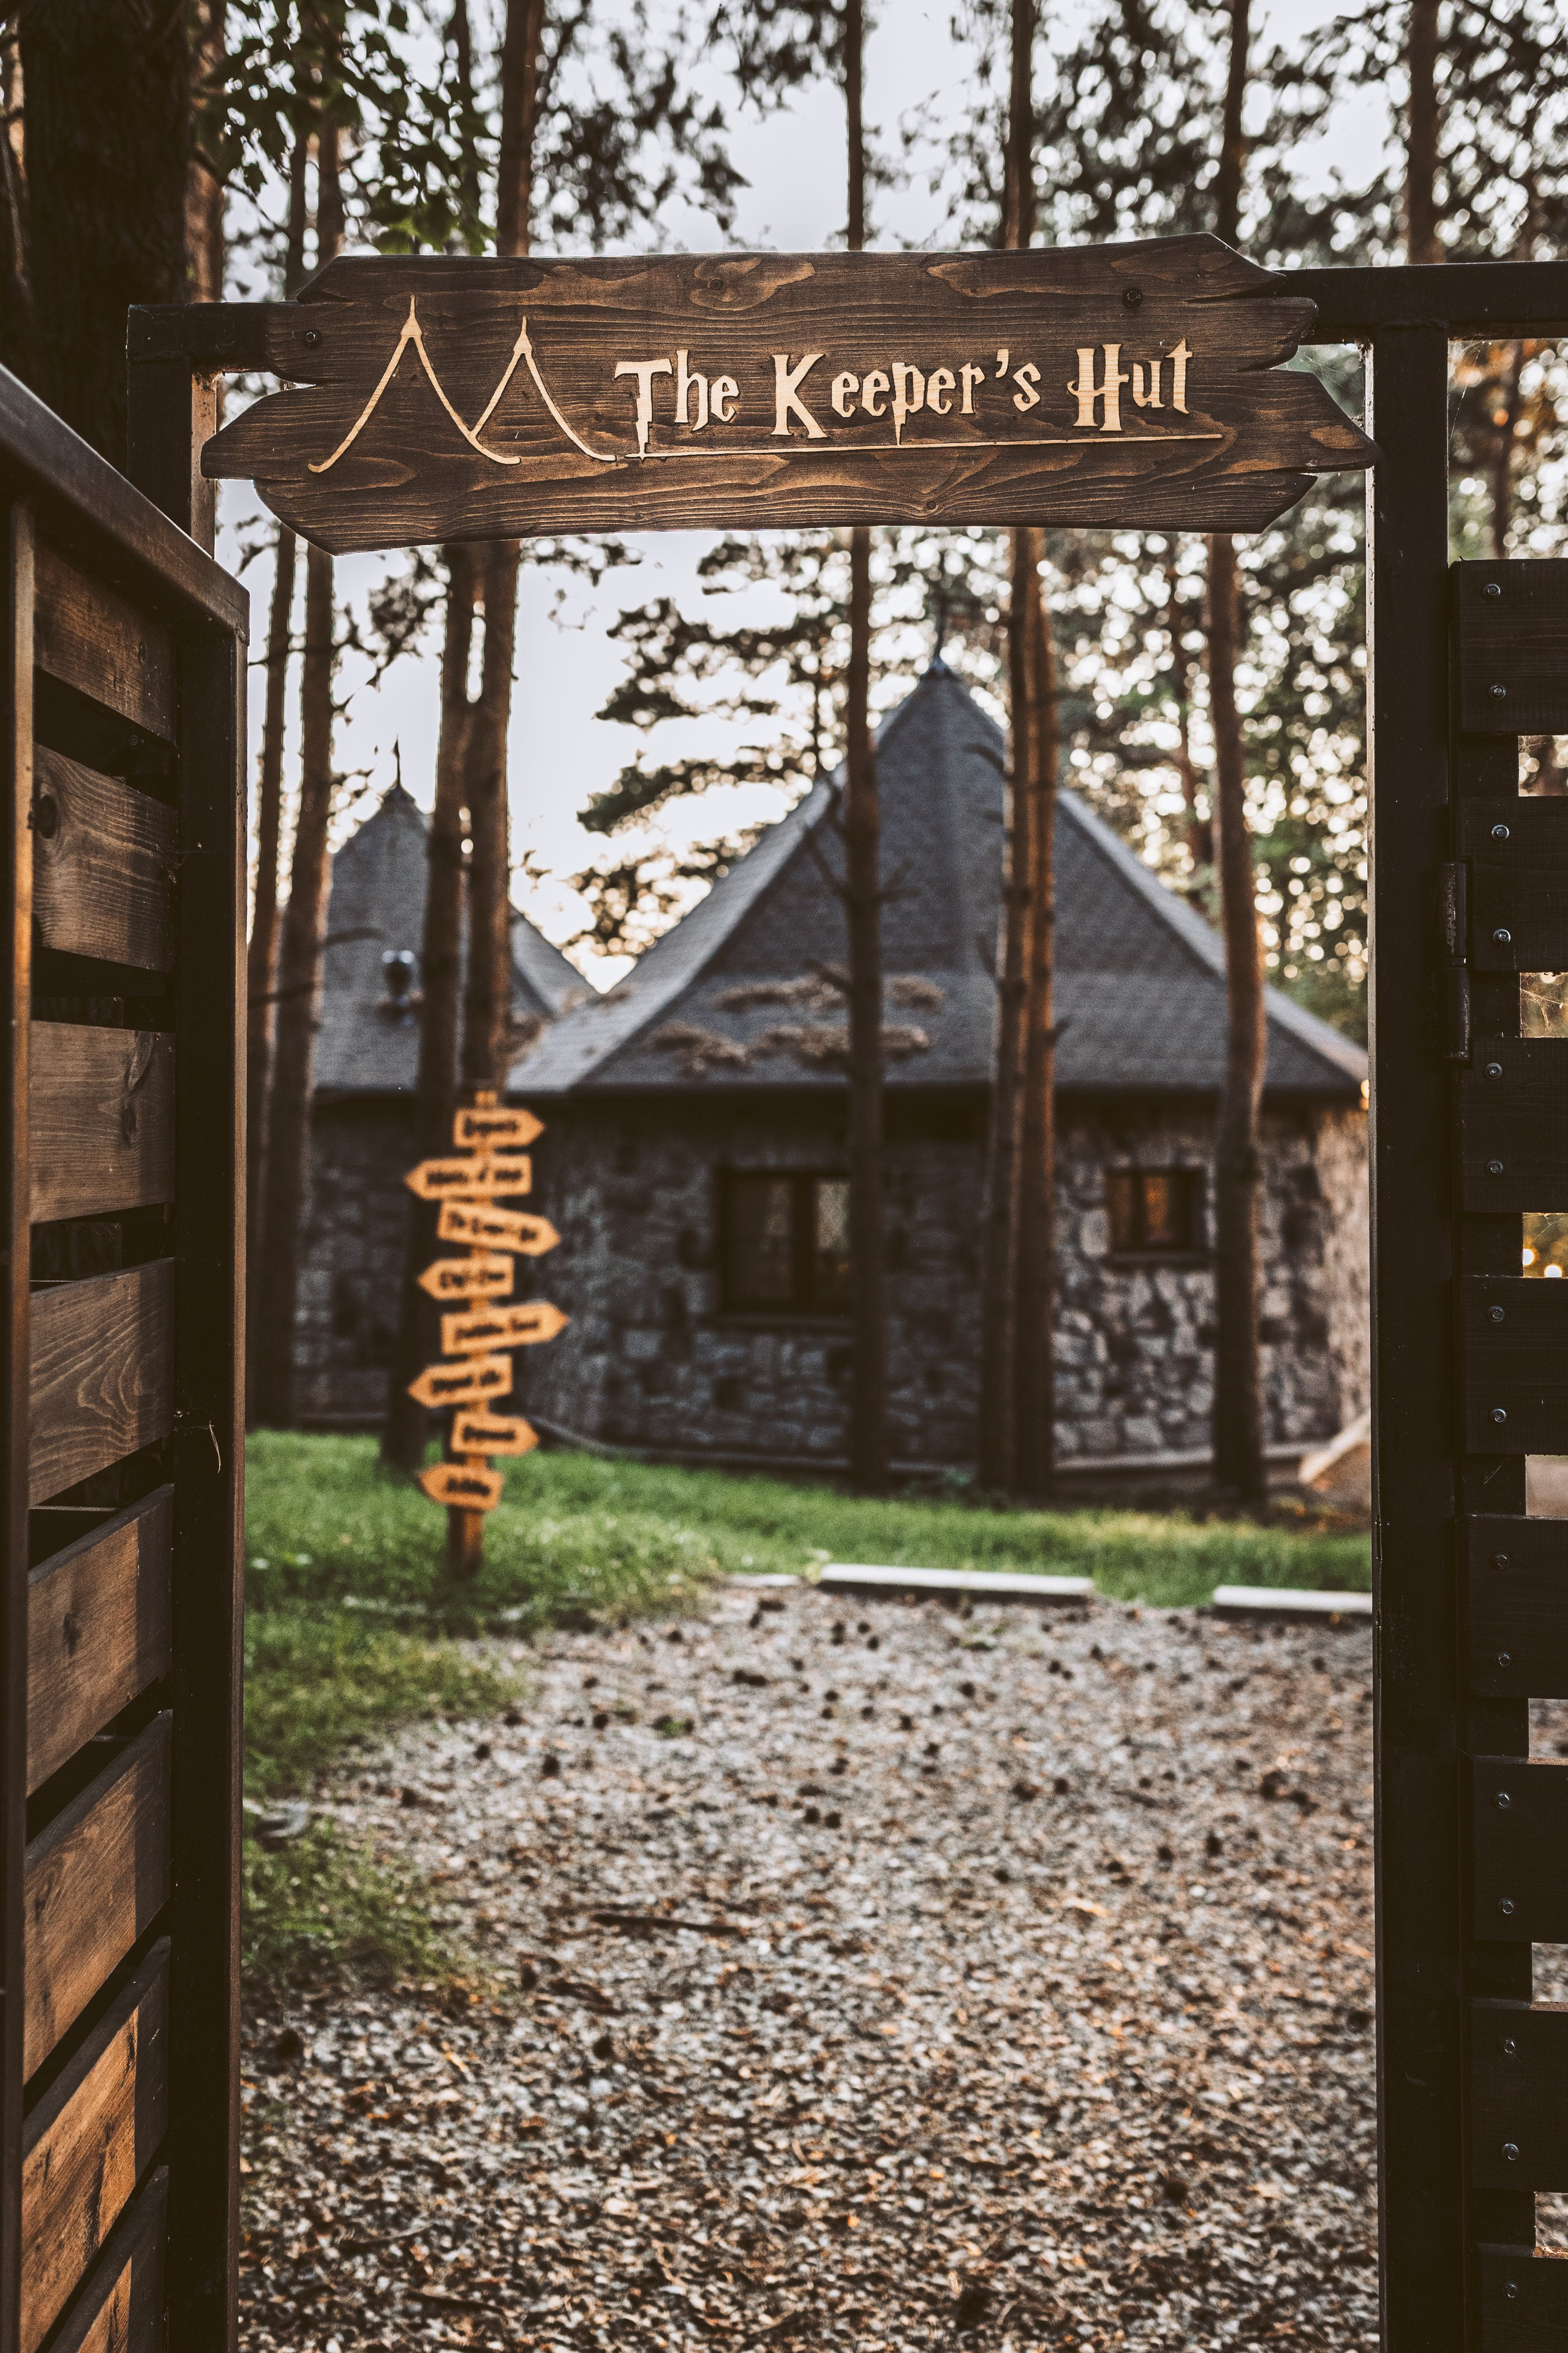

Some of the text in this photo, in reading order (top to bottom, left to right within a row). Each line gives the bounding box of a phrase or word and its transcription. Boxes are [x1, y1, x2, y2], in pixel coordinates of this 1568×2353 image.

[614, 339, 1193, 459] The Keeper's Hut
